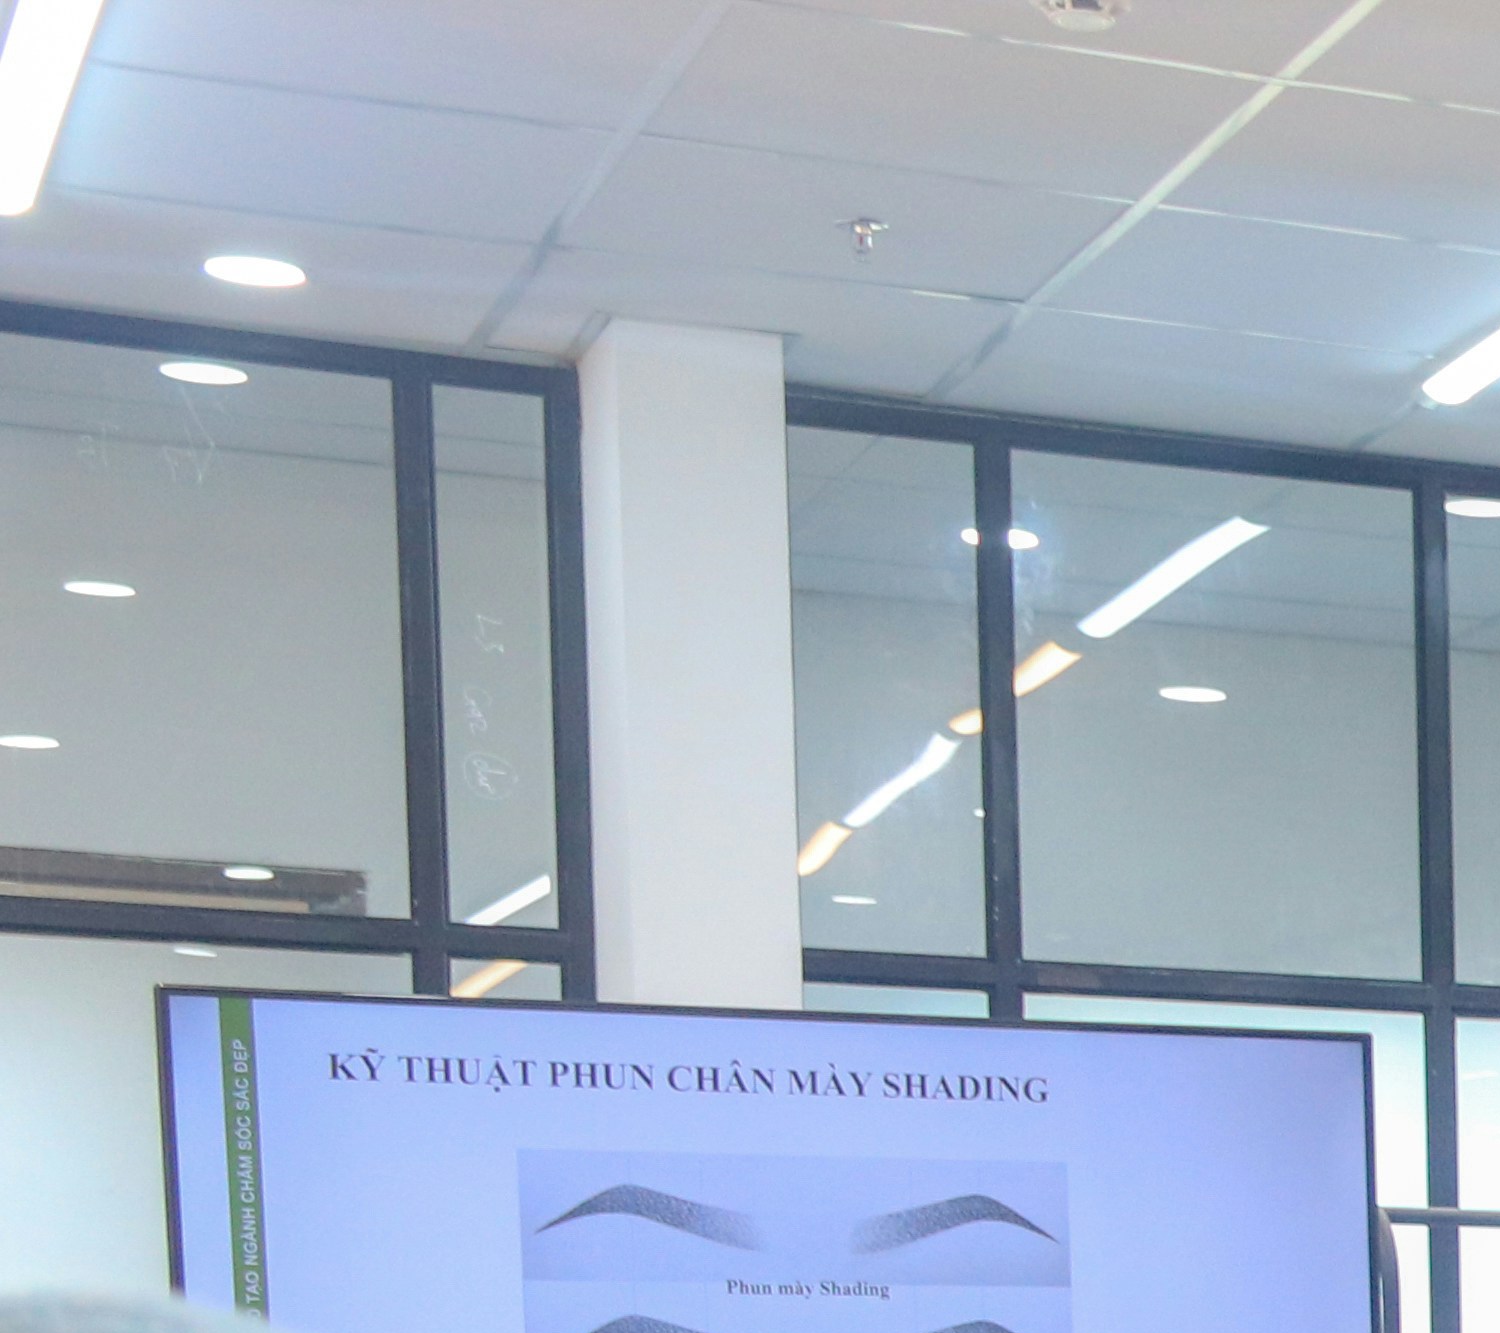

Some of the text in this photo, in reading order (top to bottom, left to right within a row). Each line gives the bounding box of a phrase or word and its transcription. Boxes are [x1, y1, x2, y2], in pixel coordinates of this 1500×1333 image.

[328, 1047, 1050, 1104] KỸ THUẬT PHUN CHÂN MÀY SHADING
[234, 1115, 253, 1151] SÓC
[240, 1207, 259, 1267] NGÀNH
[727, 1279, 891, 1300] Phun mày Shading
